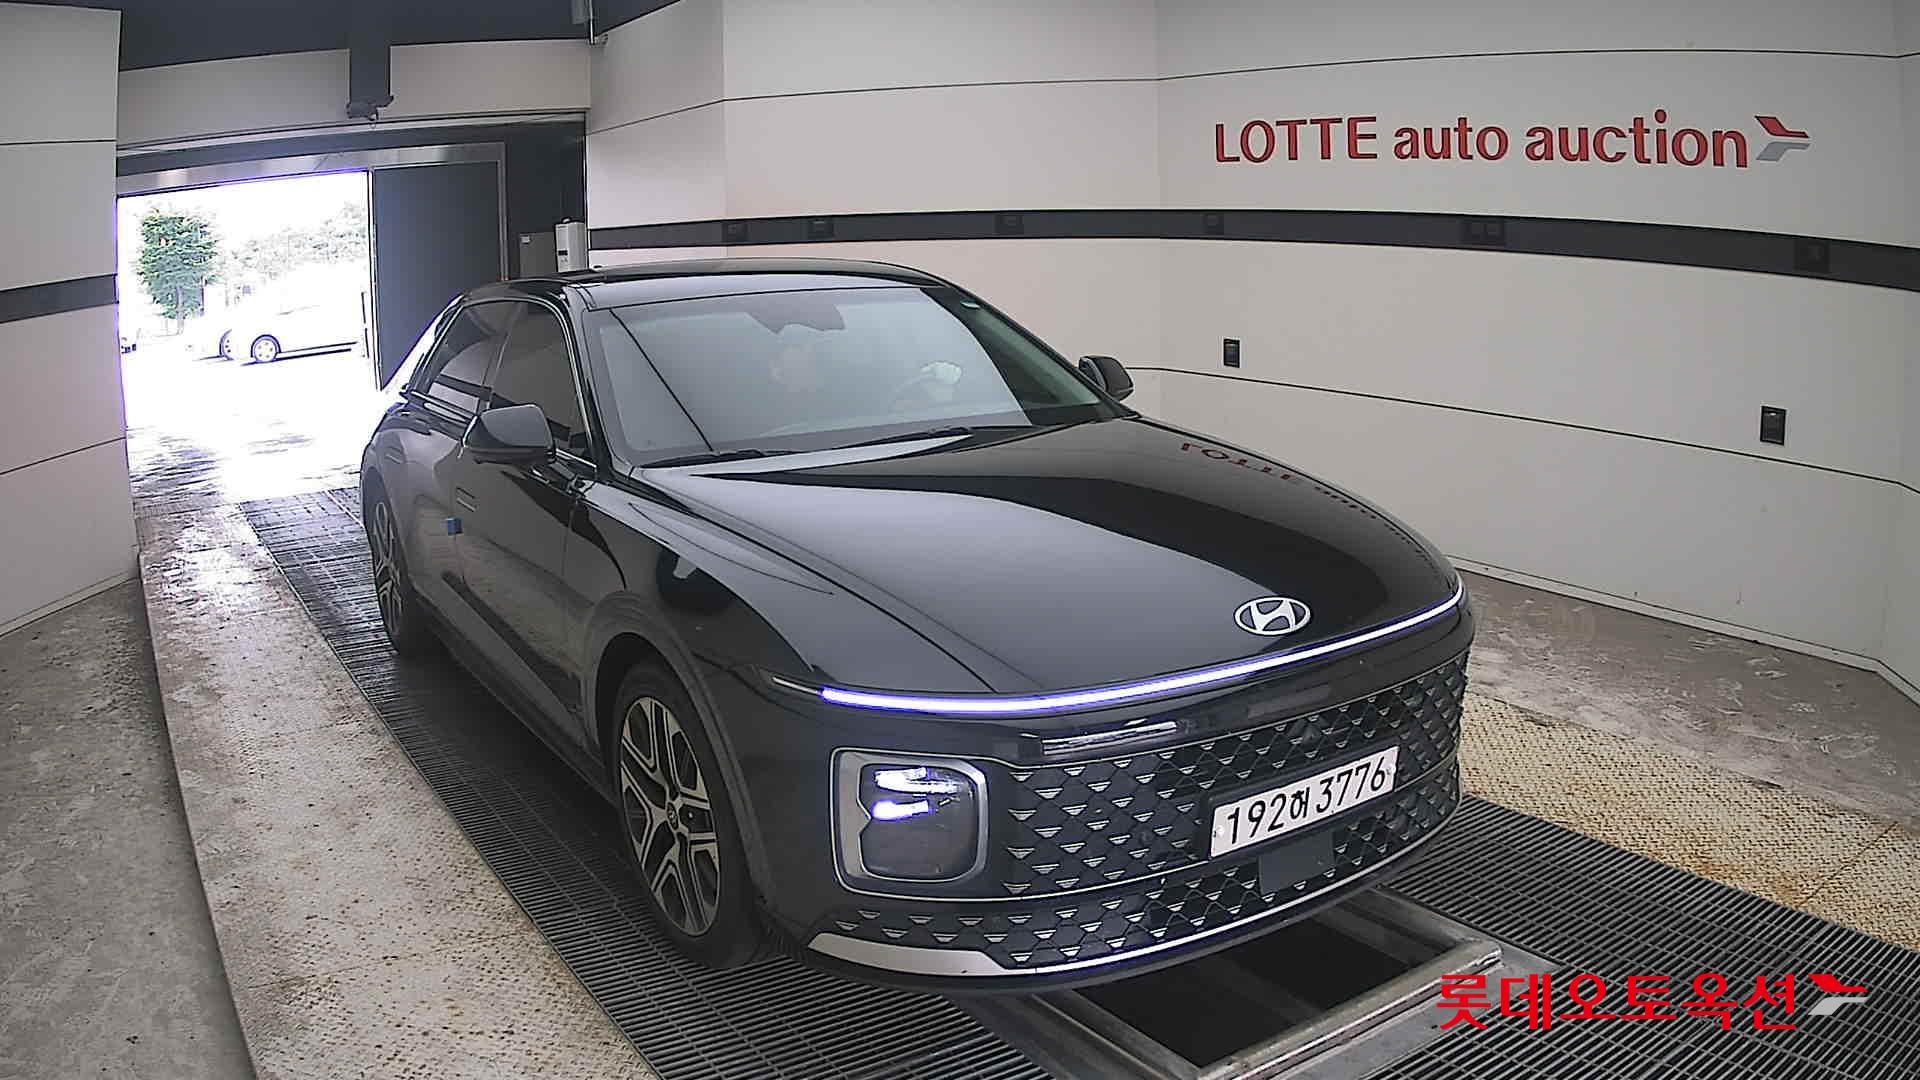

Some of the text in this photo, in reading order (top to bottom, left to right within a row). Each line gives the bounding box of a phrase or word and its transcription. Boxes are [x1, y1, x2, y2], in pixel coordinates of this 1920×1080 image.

[1215, 109, 1749, 168] LOTTE auto auction
[1316, 756, 1386, 813] 3776
